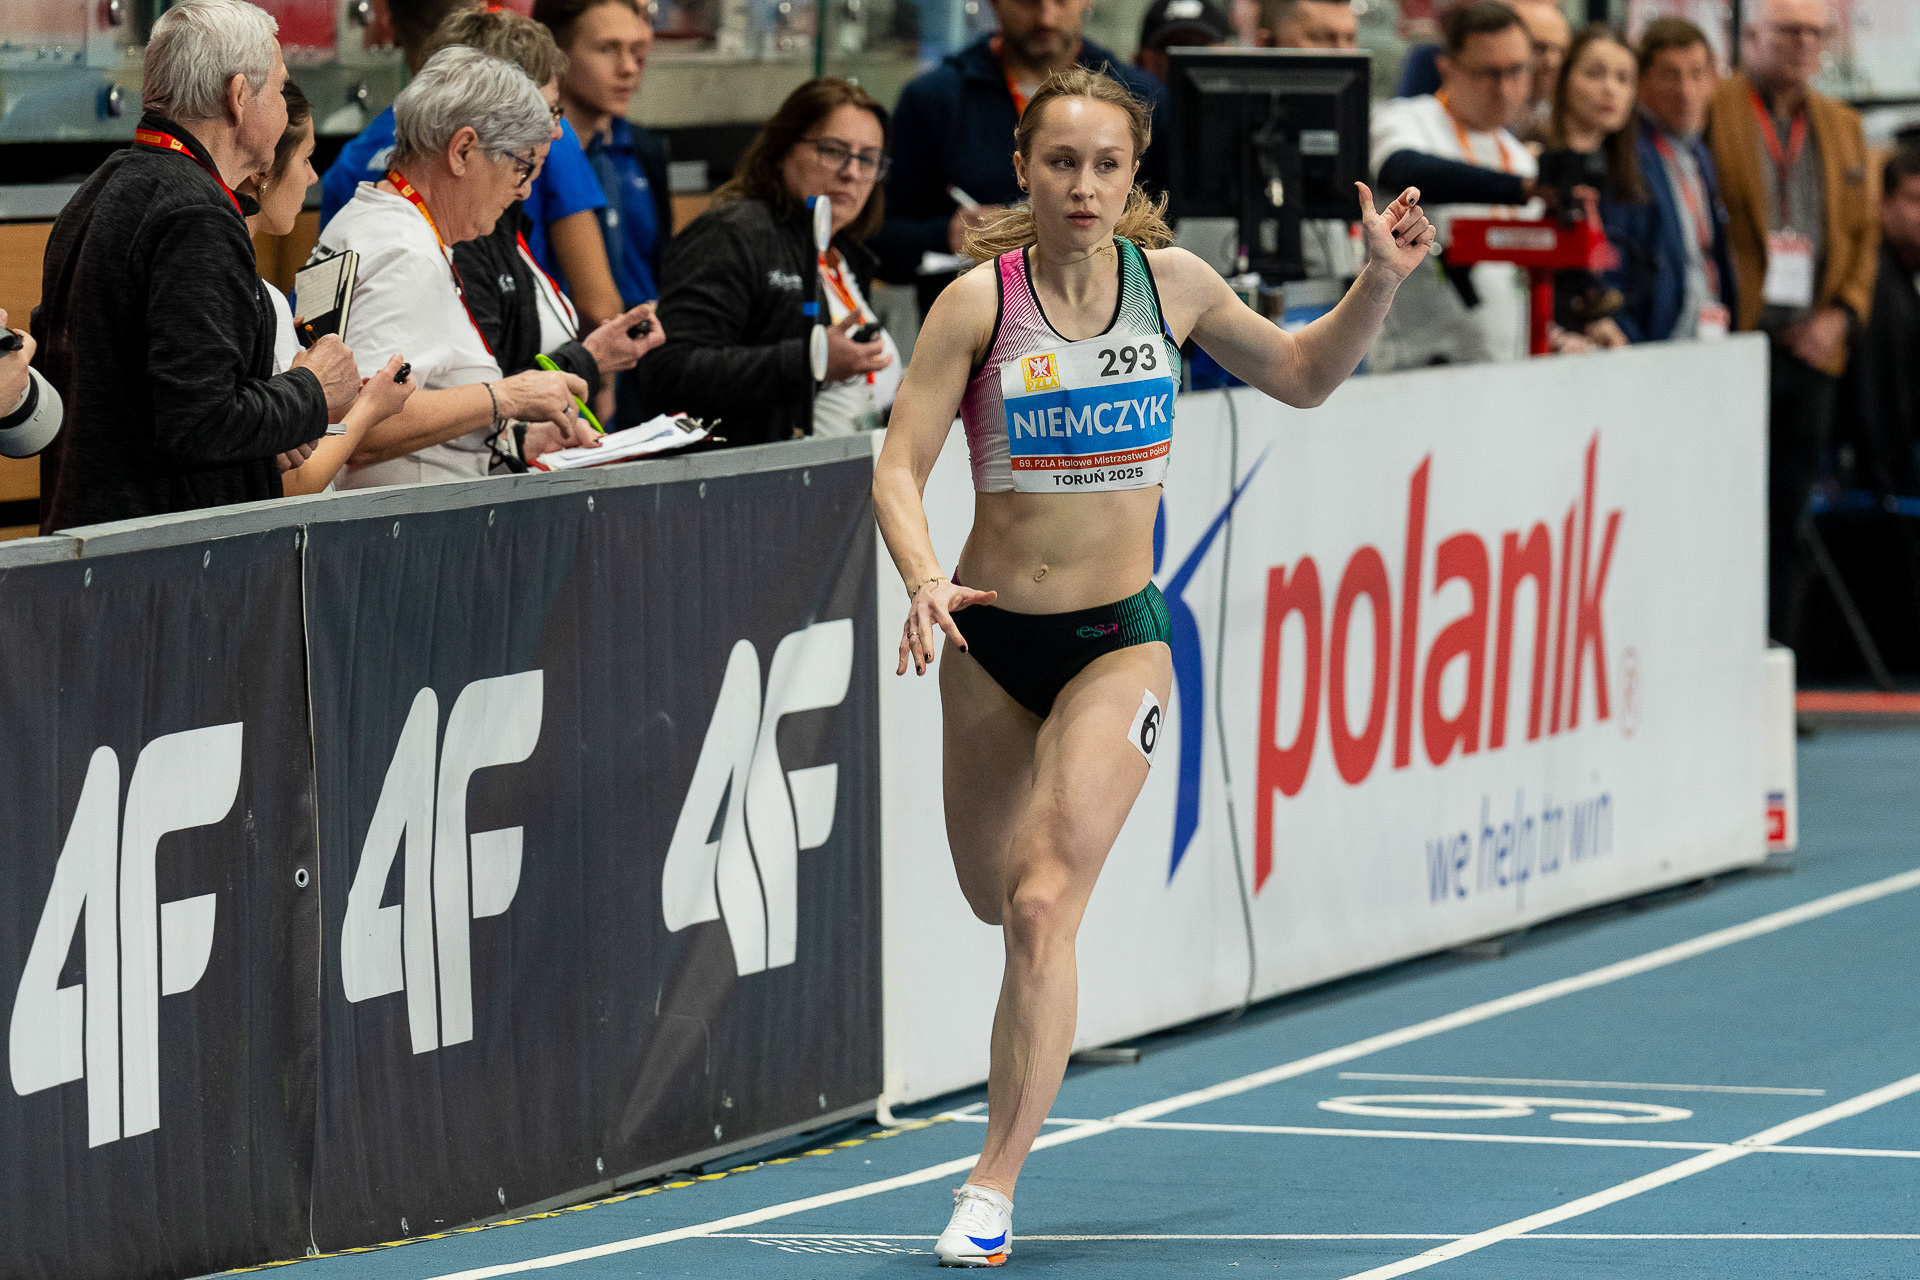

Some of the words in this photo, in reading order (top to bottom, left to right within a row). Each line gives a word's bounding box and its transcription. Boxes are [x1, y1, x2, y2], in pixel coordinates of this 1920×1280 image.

[1027, 376, 1059, 390] PZLA
[1098, 343, 1157, 377] 293
[1013, 394, 1169, 439] NIEMCZYK
[1019, 459, 1033, 468] 69.
[1034, 458, 1056, 468] PZLA
[1058, 457, 1092, 467] Halowe
[1094, 451, 1148, 465] Mistrzostwa
[1149, 445, 1168, 457] Polski
[1053, 468, 1104, 486] TORUŃ
[1108, 467, 1143, 481] 2025
[1254, 428, 1624, 896] polanik
[1140, 705, 1160, 754] 6
[662, 618, 854, 977] 4F
[341, 669, 544, 1055] 4F
[1426, 829, 1472, 904] we
[1476, 786, 1538, 912] help
[1569, 774, 1614, 864] win
[9, 721, 243, 1149] 4F
